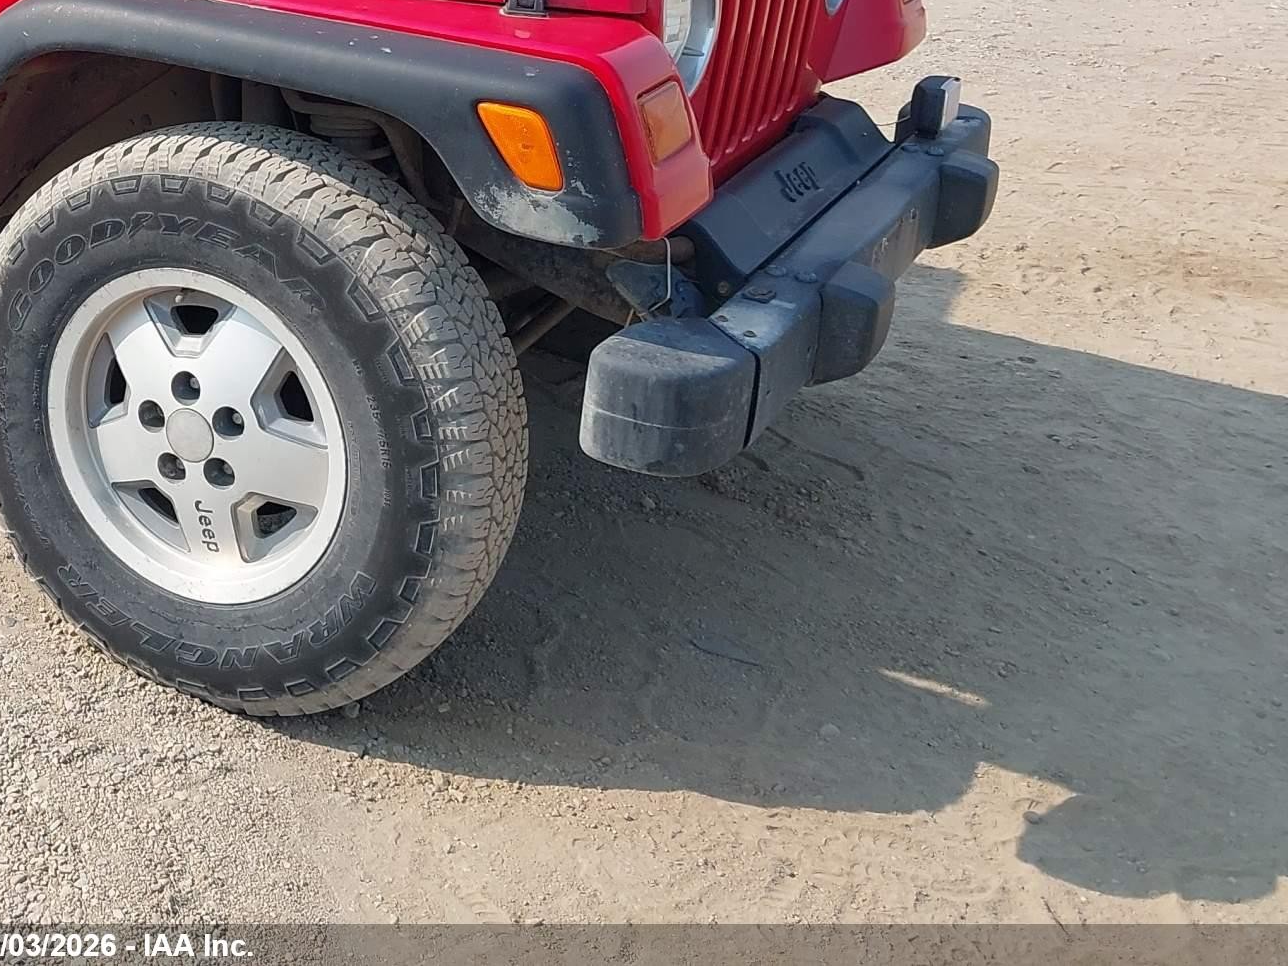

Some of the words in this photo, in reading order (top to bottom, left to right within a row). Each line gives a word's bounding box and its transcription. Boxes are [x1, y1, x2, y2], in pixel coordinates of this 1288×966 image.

[7, 211, 328, 332] GOODYEAR
[194, 499, 220, 553] Jeep
[56, 564, 378, 671] WRANGLER
